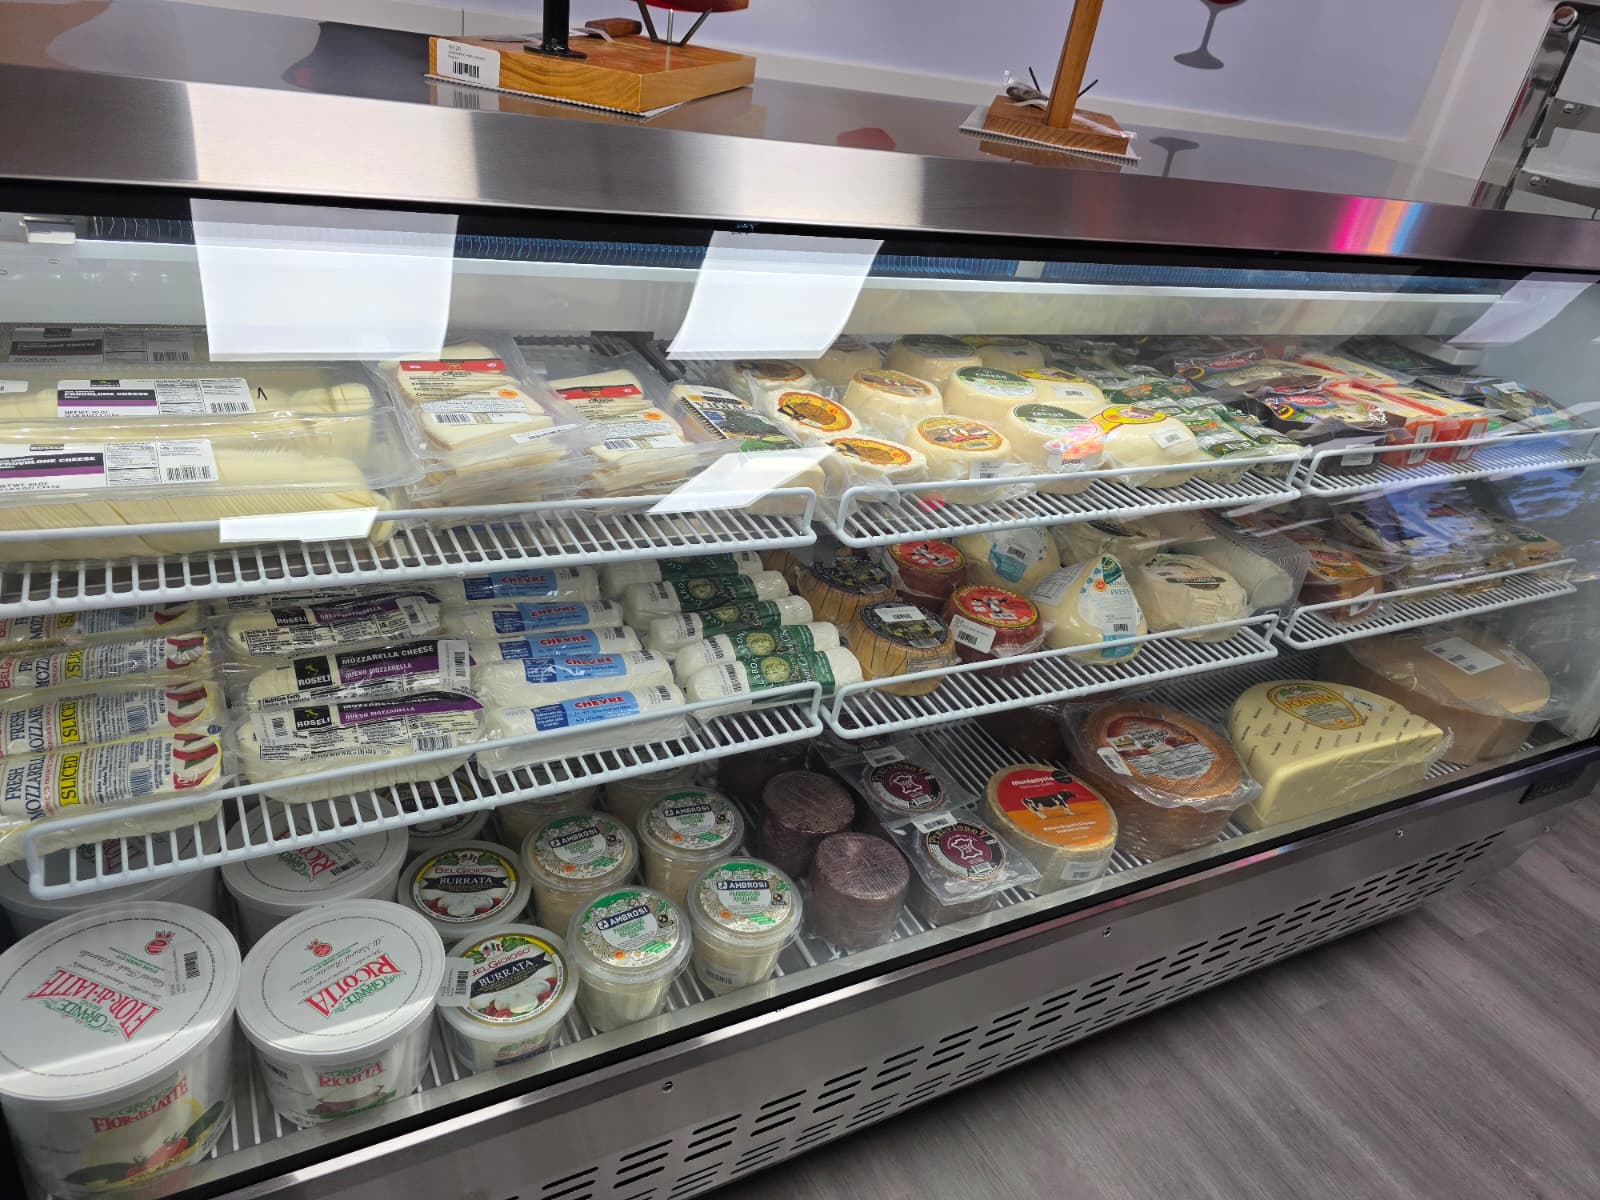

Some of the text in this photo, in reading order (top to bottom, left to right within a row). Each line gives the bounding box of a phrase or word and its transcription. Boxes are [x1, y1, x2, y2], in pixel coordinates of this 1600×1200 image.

[276, 614, 309, 625] ROSELI
[341, 644, 434, 666] MOZZARELLA CHEESE
[298, 675, 332, 687] ROSELI
[10, 710, 26, 741] FRESH
[296, 717, 331, 729] ROSELI
[5, 766, 26, 801] FRESH
[61, 753, 81, 801] SLICED
[674, 804, 711, 818] AMBROSI
[561, 828, 599, 846] AMBROSI
[439, 876, 494, 886] BURRATA
[729, 881, 768, 889] AMBROSI
[609, 906, 649, 926] AMBROSI
[478, 959, 534, 987] BURRATA
[303, 953, 402, 1019] RICOTTA
[57, 1000, 109, 1031] GRANDE
[318, 1060, 385, 1089] RICOTTA
